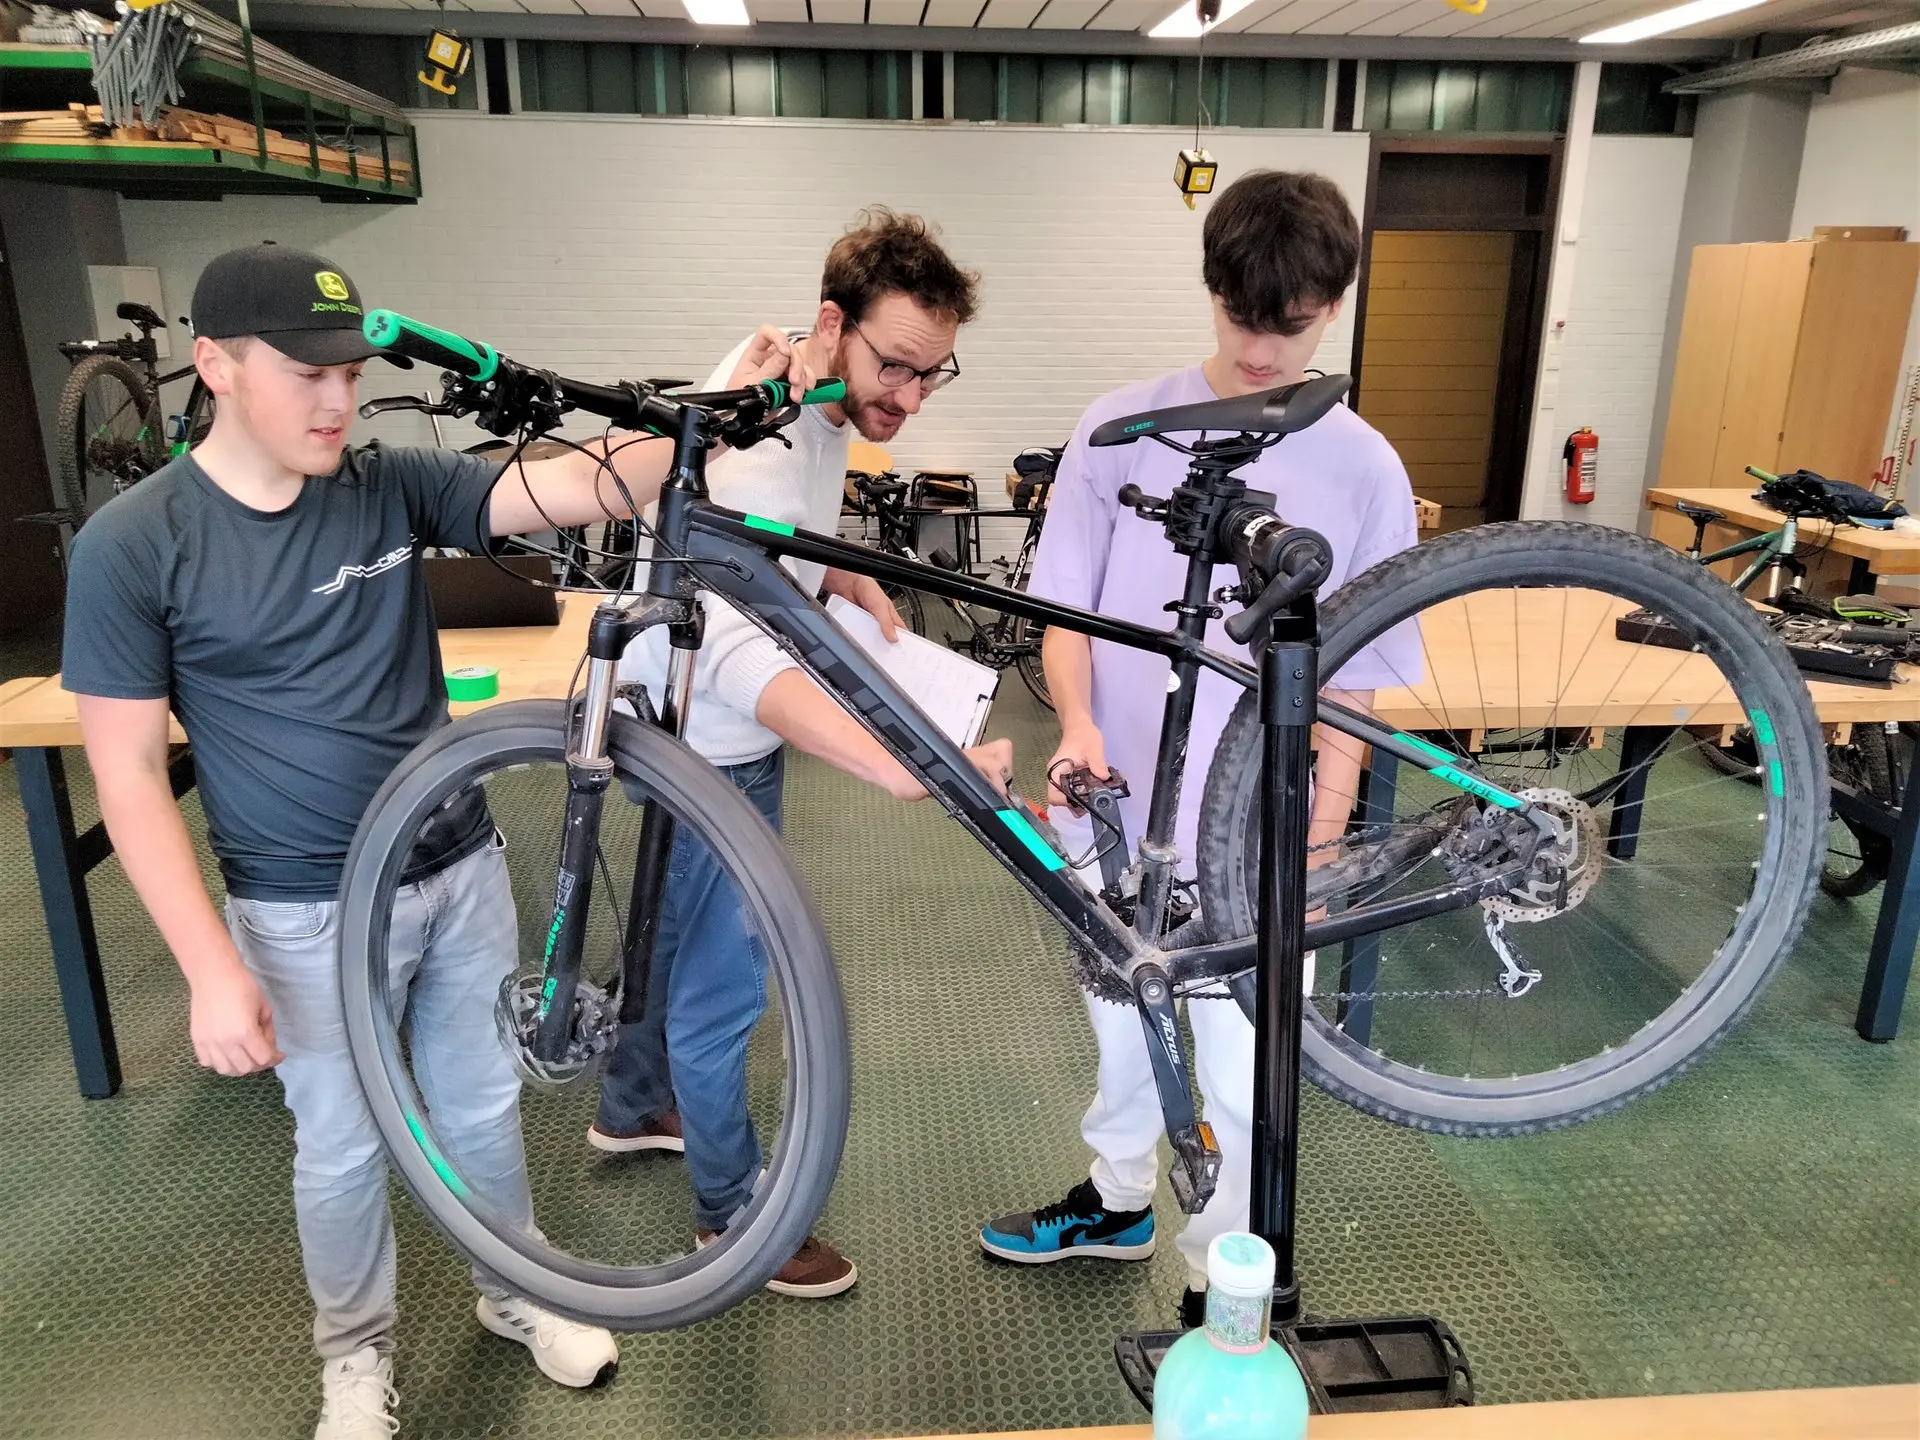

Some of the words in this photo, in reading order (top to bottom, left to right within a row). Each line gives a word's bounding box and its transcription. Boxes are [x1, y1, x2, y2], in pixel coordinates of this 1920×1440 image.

[311, 302, 339, 312] JOHN
[1123, 420, 1155, 433] CUBE
[1445, 769, 1498, 799] CUBE
[1158, 1011, 1181, 1065] ALTUS
